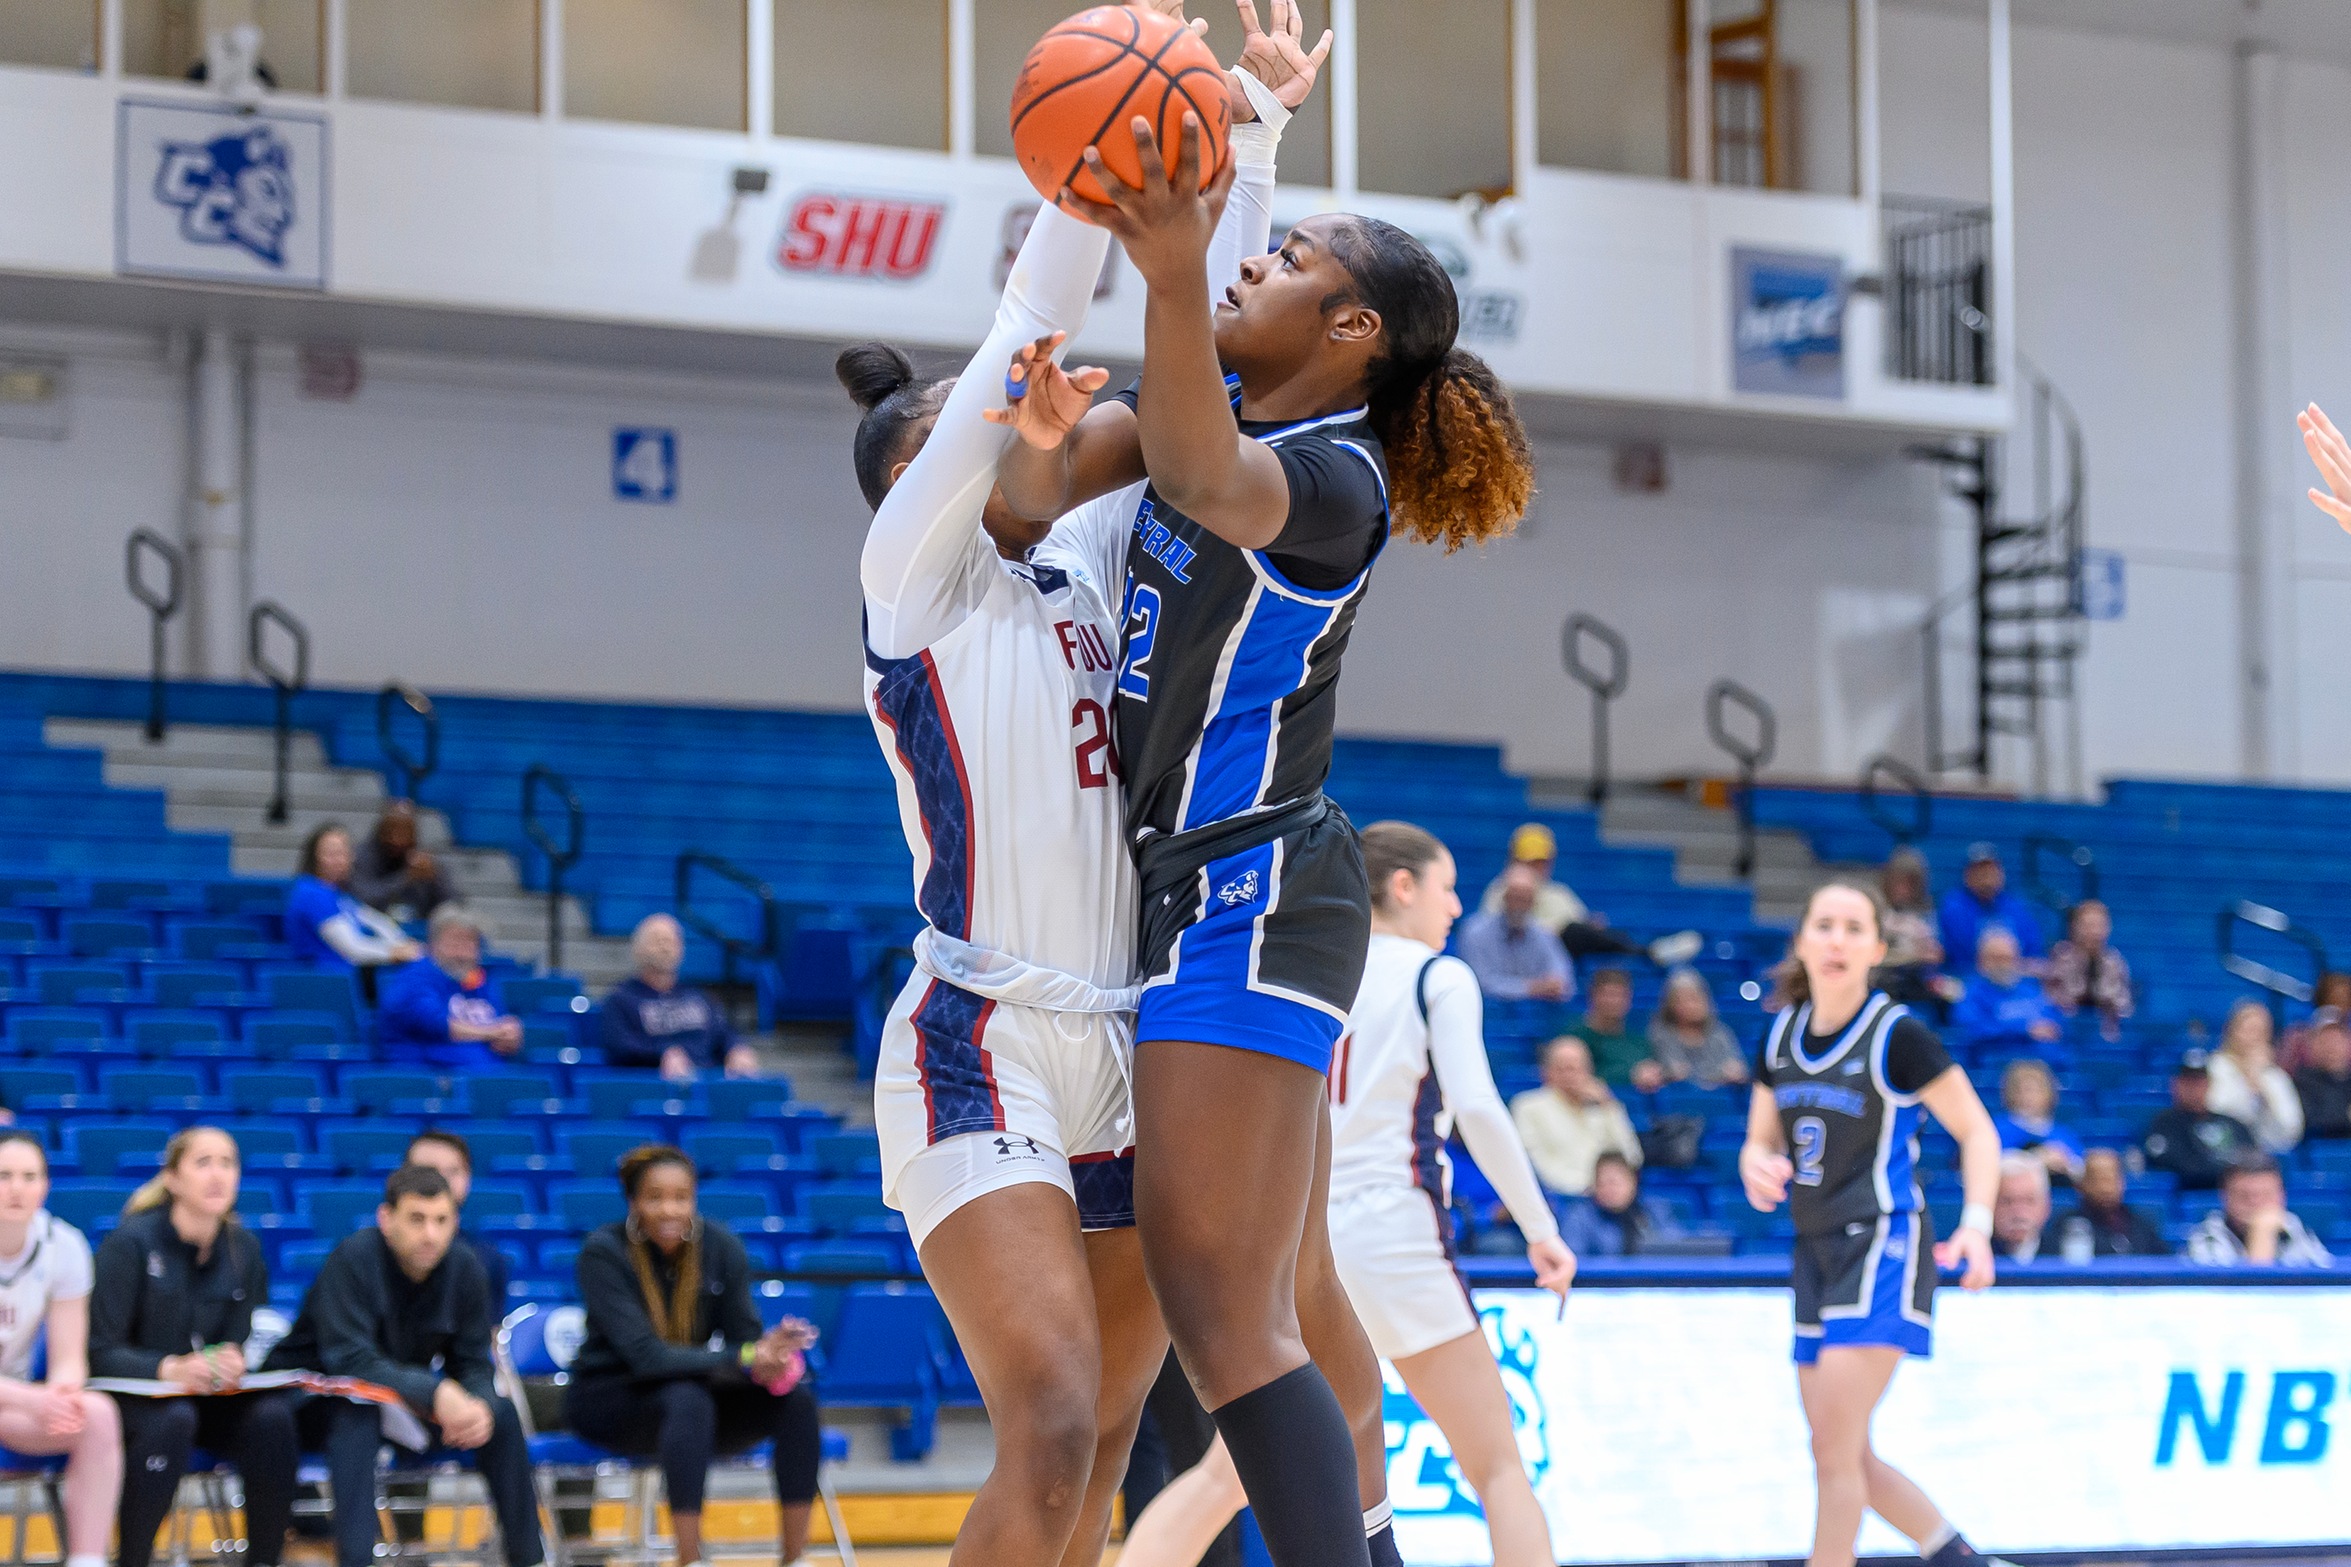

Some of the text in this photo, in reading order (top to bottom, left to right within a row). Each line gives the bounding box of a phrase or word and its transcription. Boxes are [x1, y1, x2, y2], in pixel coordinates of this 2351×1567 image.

[777, 194, 944, 279] SHU
[623, 438, 667, 493] 4
[1118, 565, 1162, 704] 2
[995, 1155, 1021, 1165] UNDER
[1792, 1116, 1827, 1187] 2
[2154, 1368, 2351, 1466] NB
